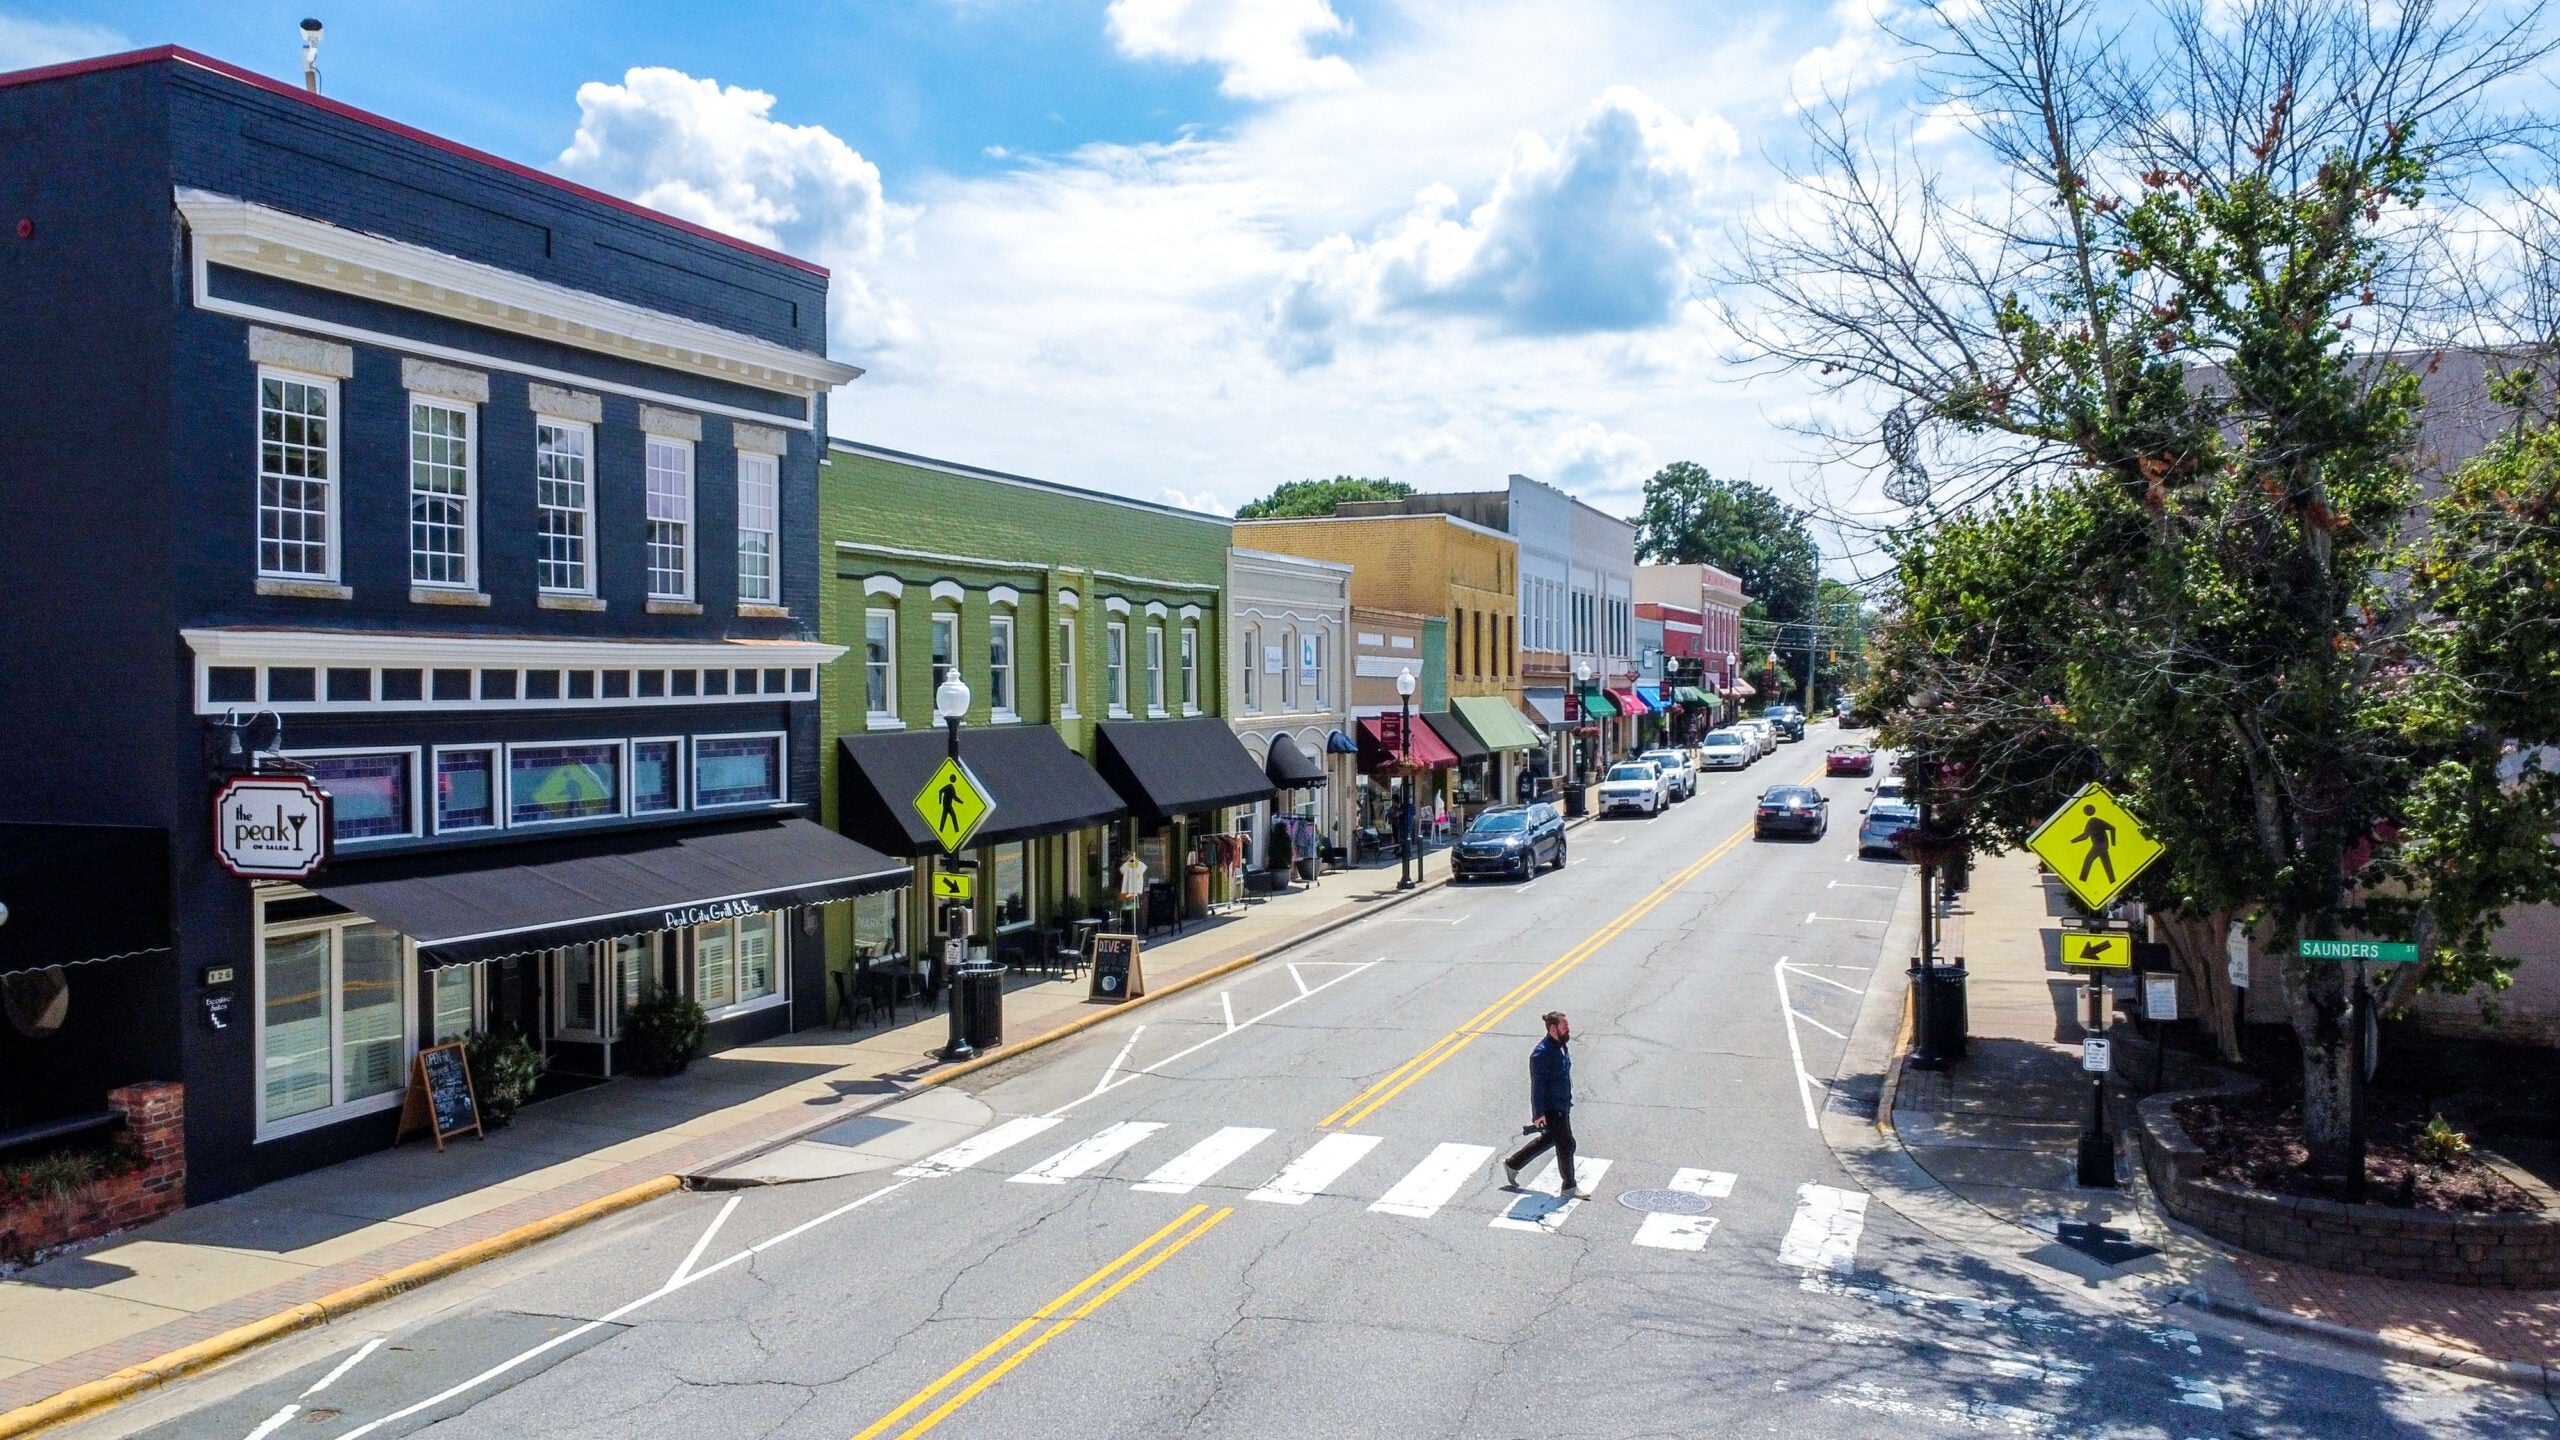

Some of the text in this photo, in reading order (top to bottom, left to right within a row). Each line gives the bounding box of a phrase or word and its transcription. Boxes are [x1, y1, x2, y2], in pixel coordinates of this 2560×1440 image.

[236, 804, 252, 820] the
[235, 804, 290, 849] peak
[665, 900, 759, 927] Peak City Grill & Bar
[1098, 940, 1121, 953] DIVE
[2303, 942, 2416, 958] SAUNDERS ST
